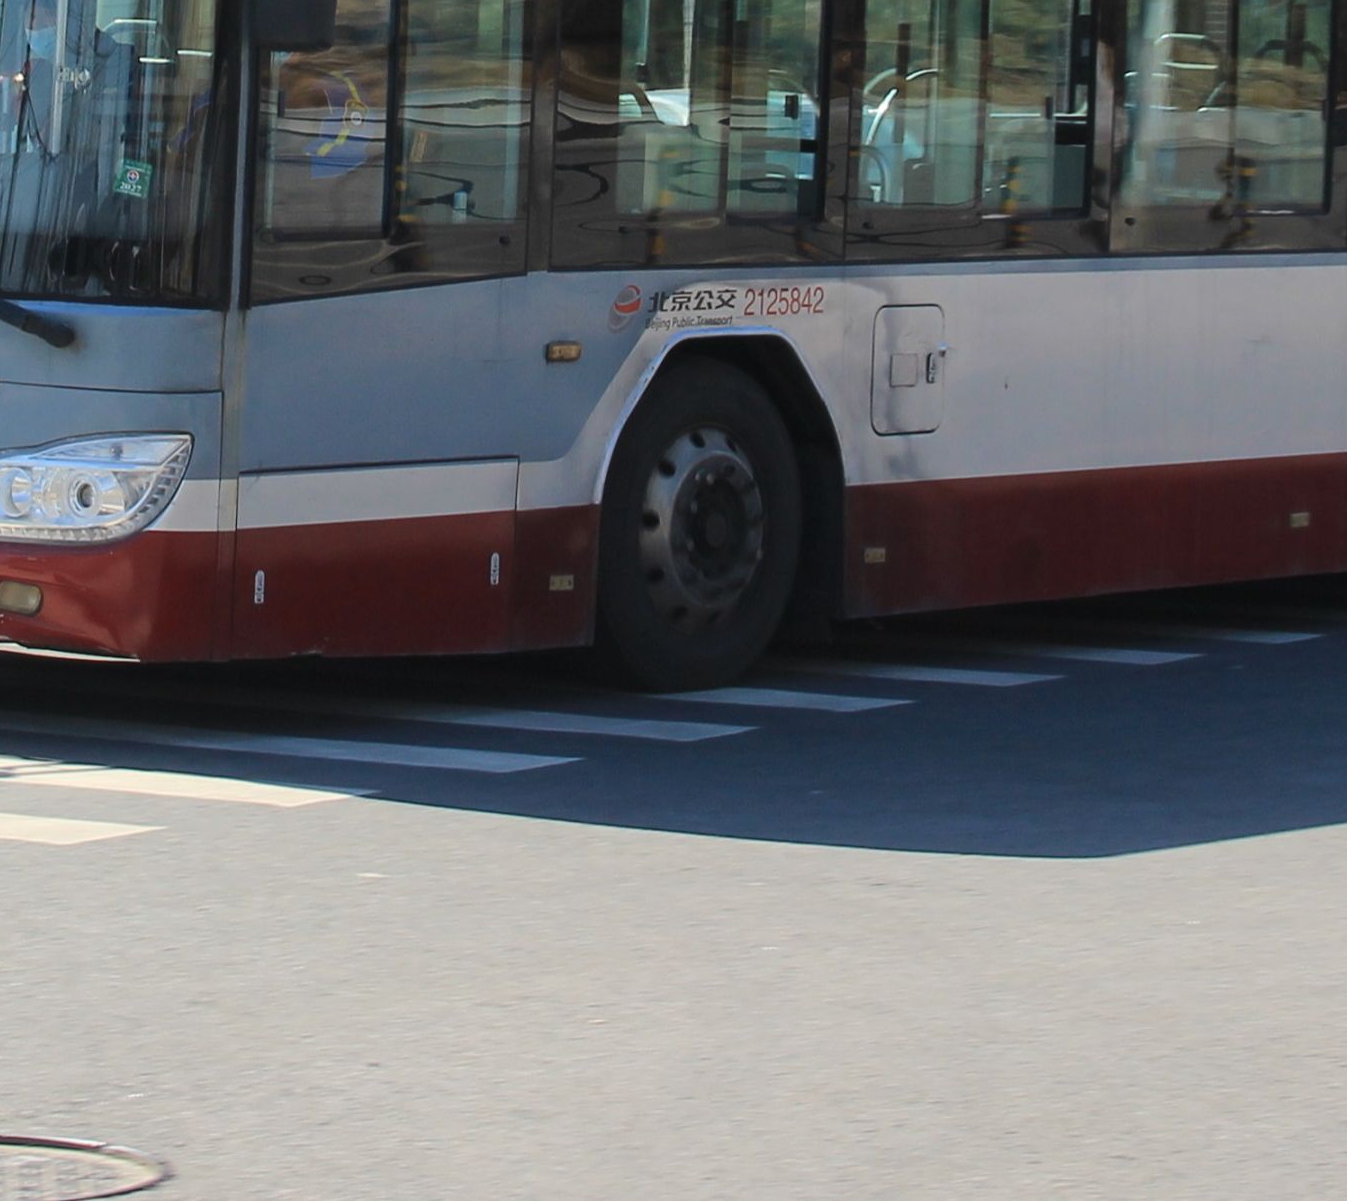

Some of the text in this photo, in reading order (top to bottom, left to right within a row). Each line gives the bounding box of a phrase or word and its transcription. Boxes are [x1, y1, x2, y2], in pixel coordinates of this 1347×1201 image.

[119, 181, 142, 194] 2027
[648, 286, 824, 316] 北京公交 2125842
[644, 315, 733, 331] Beijing Public Transport
